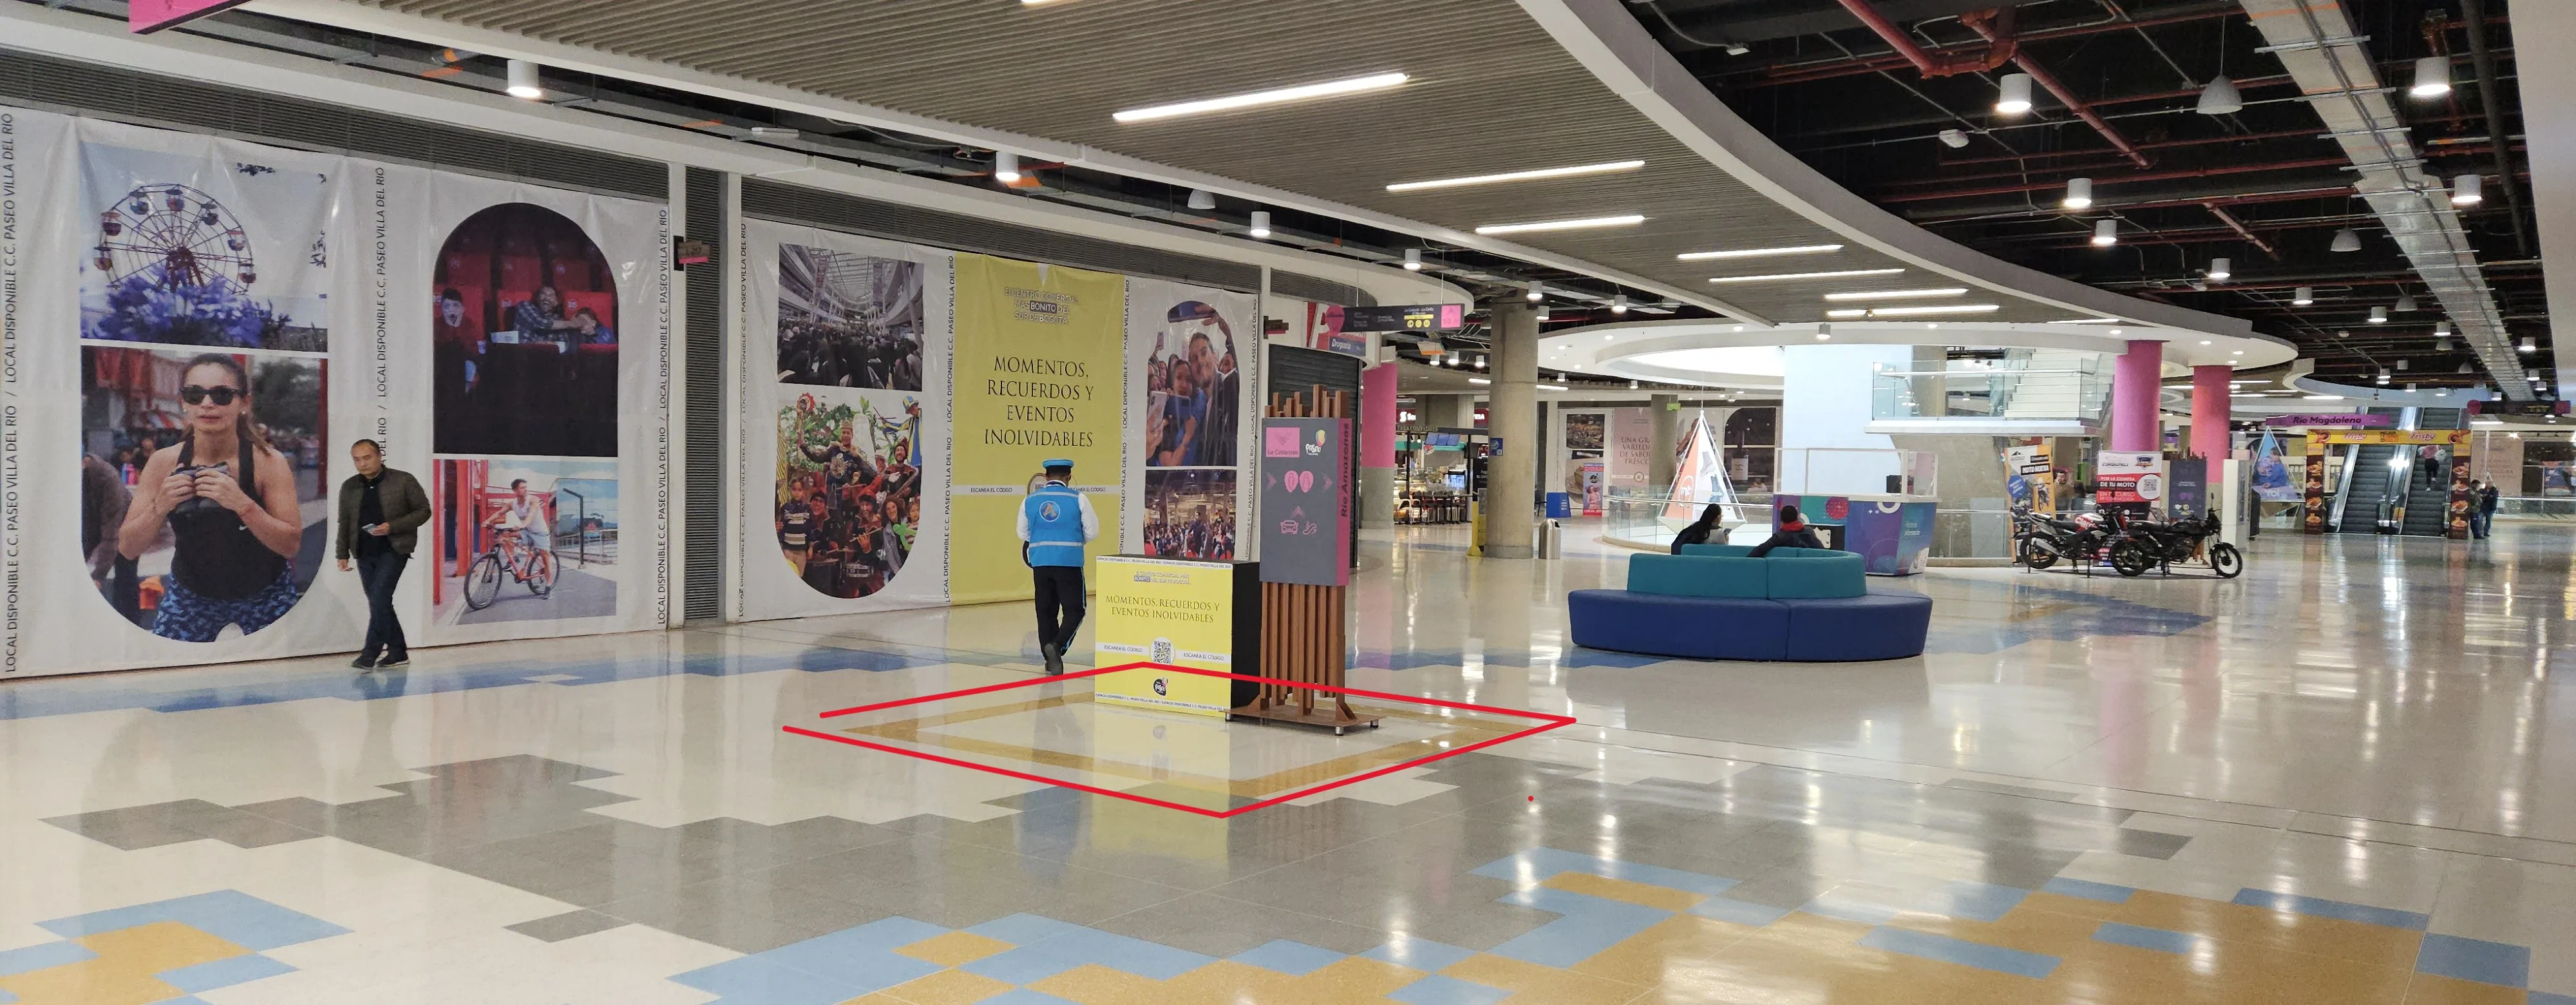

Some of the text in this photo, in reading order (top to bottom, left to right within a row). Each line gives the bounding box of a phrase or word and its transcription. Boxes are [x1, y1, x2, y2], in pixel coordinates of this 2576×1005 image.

[1, 113, 16, 382] LOCAL DISPONIBLE C.C. PASEO VILLA DEL RIO
[375, 168, 386, 396] LOCAL DISPONIBLE C.C. PASEO VILLA DEL RIO
[1030, 302, 1056, 312] BONITO
[994, 356, 1088, 378] MOMENTOS,
[987, 379, 1094, 400] RECUERDOS Y
[1007, 405, 1074, 423] EVENTOS
[2309, 416, 2362, 425] Magdalena
[377, 418, 386, 434] RIO
[985, 429, 1092, 446] INOLVIDABLES
[5, 406, 18, 672] LOCAL DISPONIBLE C.C. PASEO VILLA DEL RIO
[1160, 598, 1211, 611] RECUERDOS
[1214, 603, 1220, 611] Y
[1111, 606, 1214, 623] EVENTOS INOLVIDABLES
